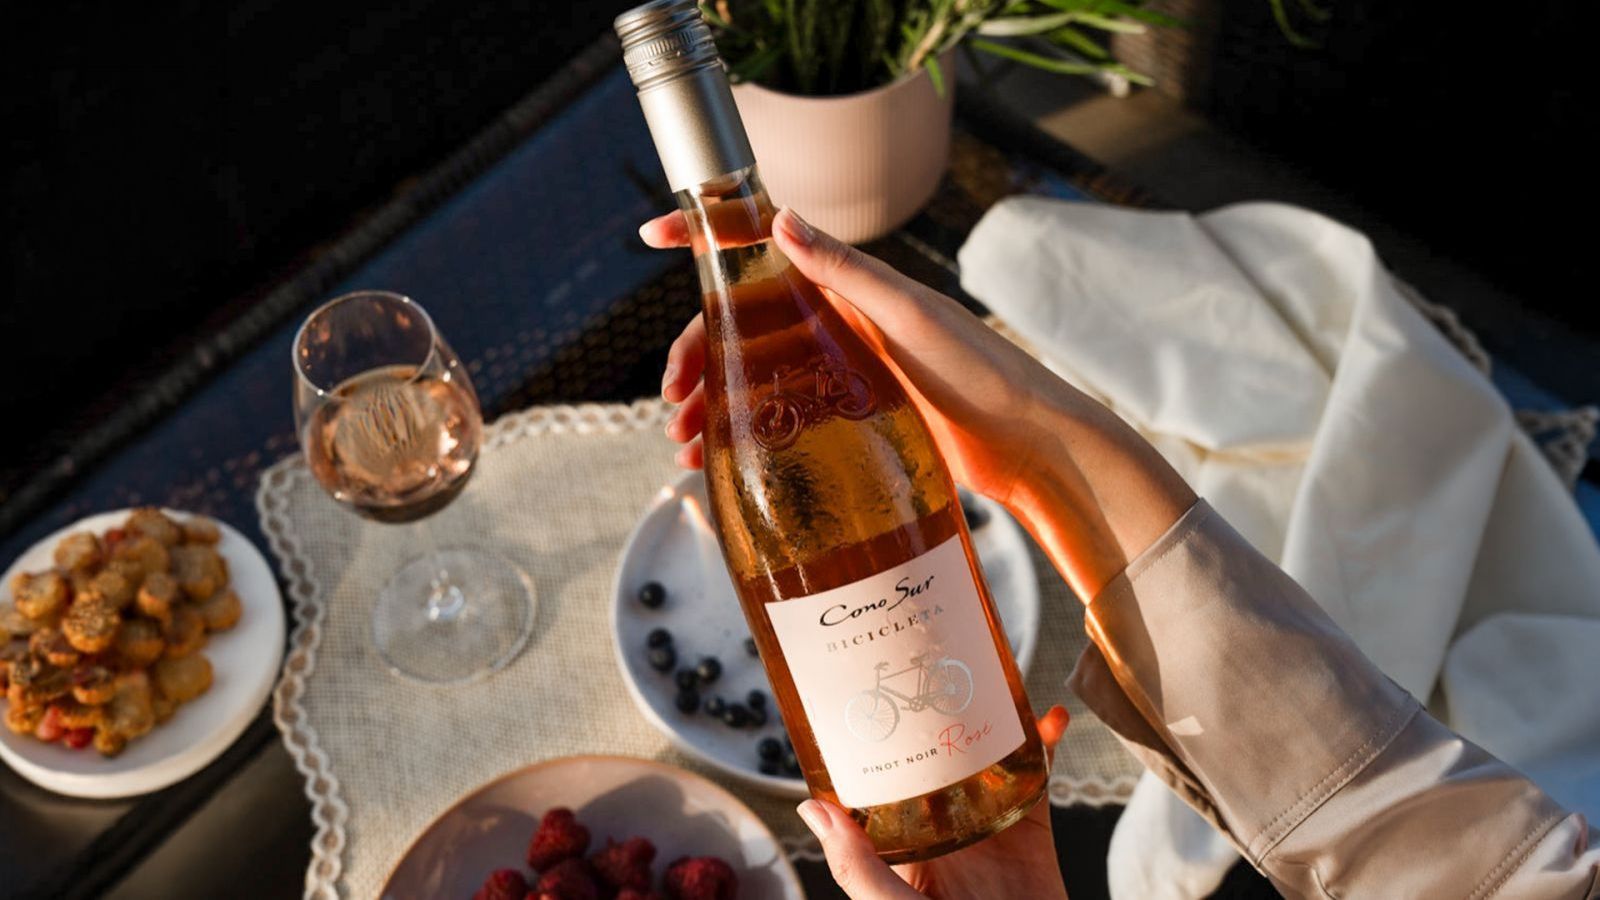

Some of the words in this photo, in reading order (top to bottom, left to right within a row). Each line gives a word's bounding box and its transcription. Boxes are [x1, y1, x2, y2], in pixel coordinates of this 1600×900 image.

[819, 599, 887, 626] Cono
[887, 575, 935, 612] Sur
[826, 604, 944, 653] BICICLETA
[862, 760, 900, 775] PINOT
[906, 748, 939, 764] NOIR
